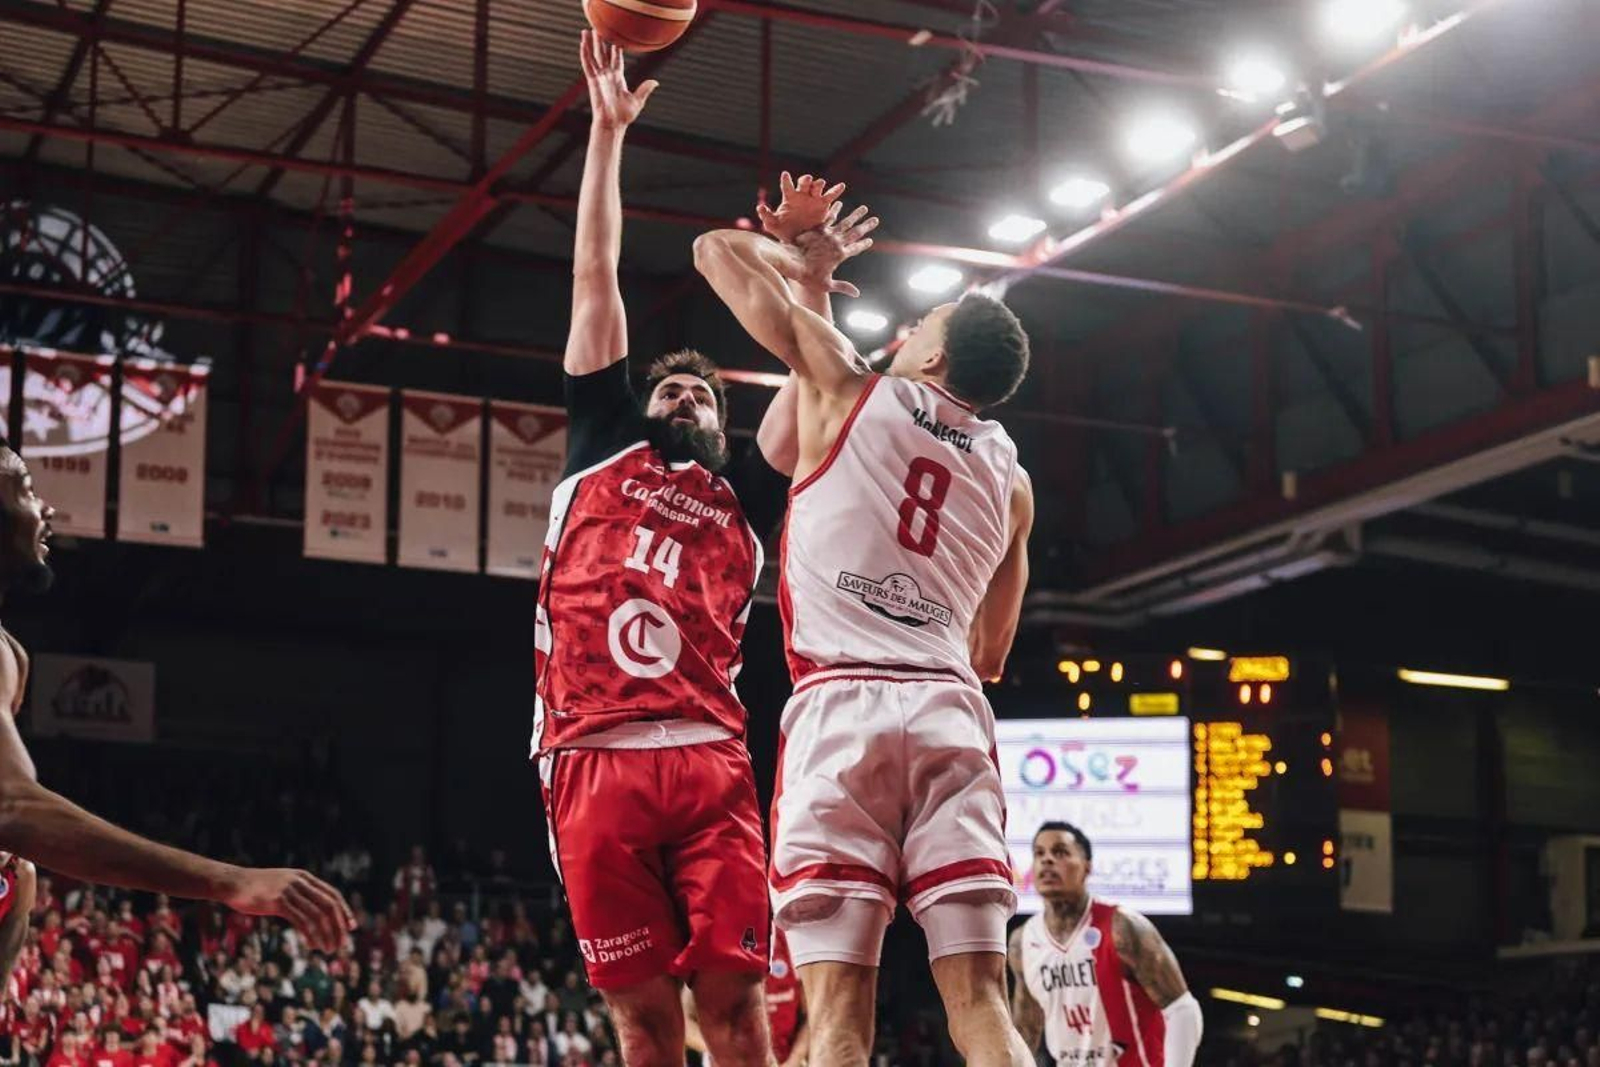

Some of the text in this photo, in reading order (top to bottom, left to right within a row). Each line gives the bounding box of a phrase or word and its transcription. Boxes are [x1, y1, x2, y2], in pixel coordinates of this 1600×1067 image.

[897, 456, 952, 558] 8
[624, 525, 683, 589] 14
[841, 575, 889, 599] SAVEURS
[890, 593, 907, 605] DES
[908, 599, 951, 622] MAUGES
[594, 927, 650, 950] Zaragoza
[1040, 959, 1098, 991] CHOLET
